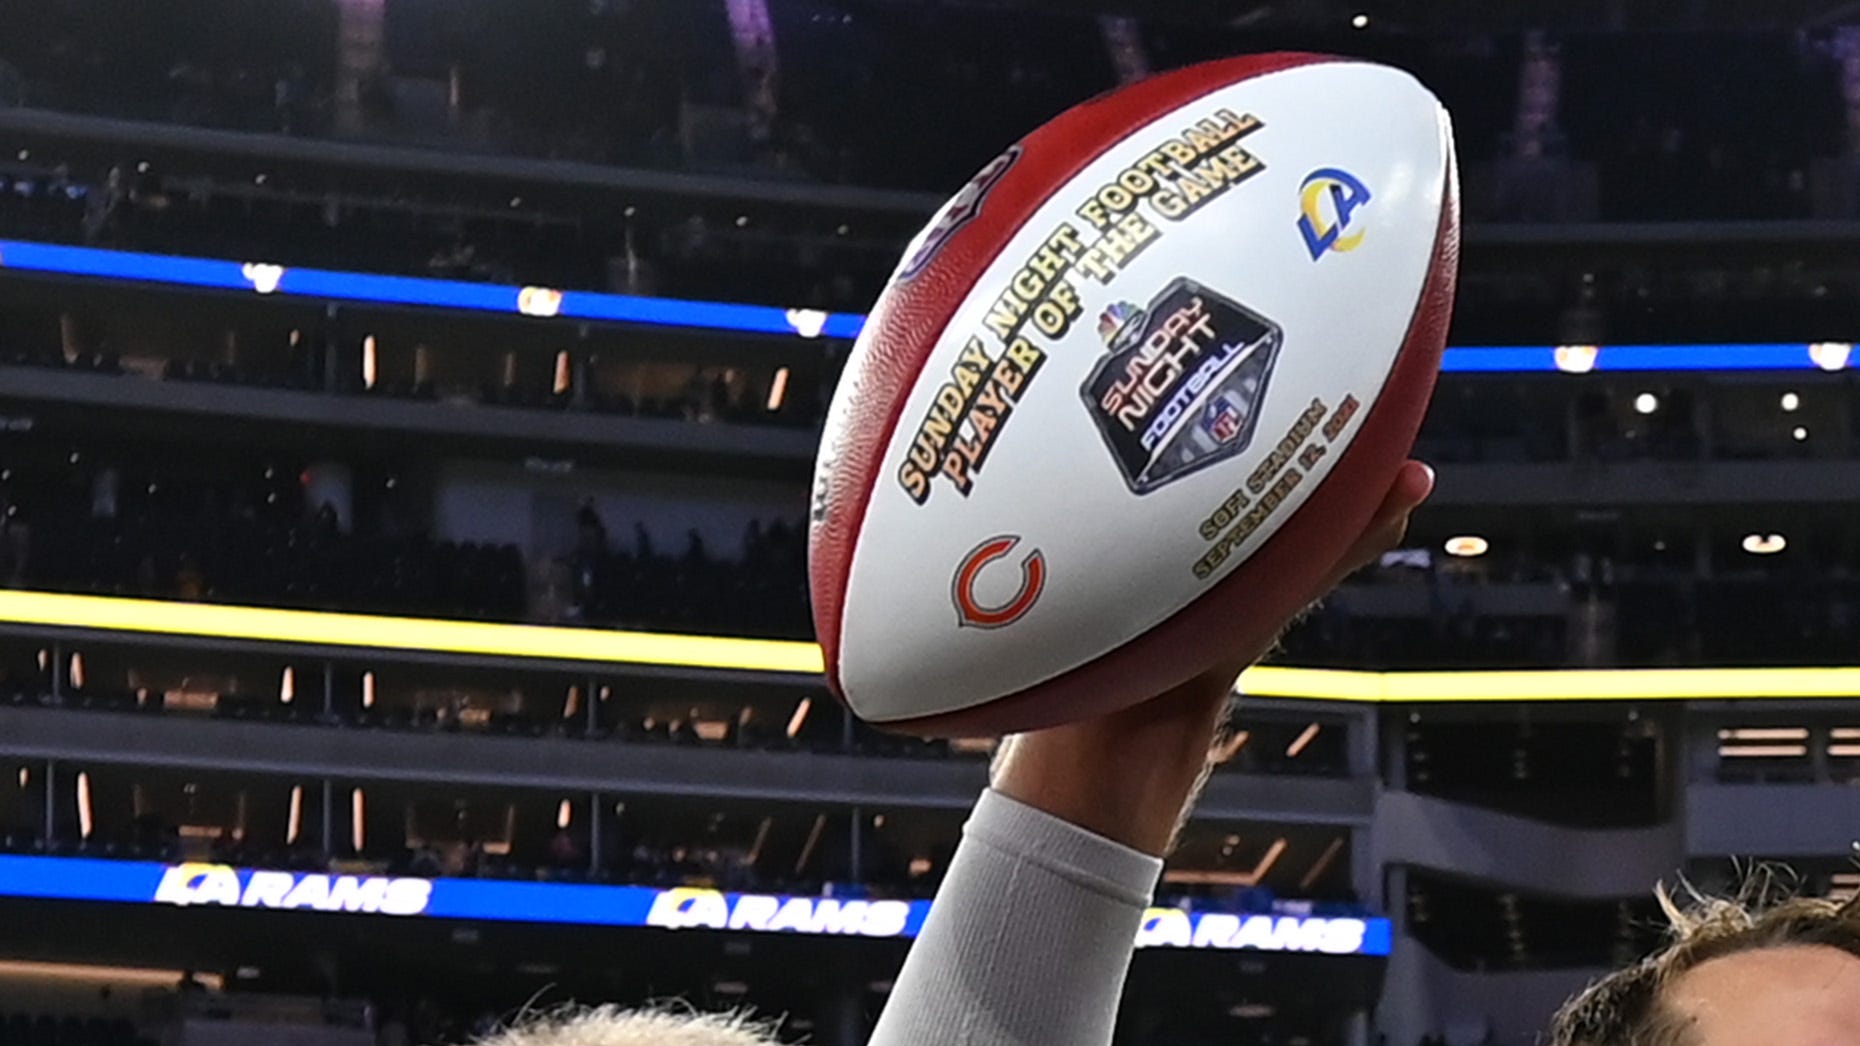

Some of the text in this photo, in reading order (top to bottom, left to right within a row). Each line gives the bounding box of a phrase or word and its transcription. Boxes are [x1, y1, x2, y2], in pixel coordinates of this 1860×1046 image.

[899, 334, 1000, 505] SUNDAY
[983, 222, 1080, 345] NIGHT
[1075, 108, 1265, 227] FOOTBALL
[942, 336, 1048, 498] PLAYER
[1032, 279, 1084, 341] OF
[1078, 212, 1162, 286] THE
[1149, 144, 1267, 222] GAME
[1101, 297, 1203, 416] SUNDAY
[1117, 313, 1216, 432] NIGHT
[1141, 342, 1246, 450] FOOTBALL
[1246, 397, 1328, 494] STADIUM
[1192, 468, 1303, 580] SEPTEMBER
[241, 870, 432, 915] RAMS
[728, 894, 909, 936] RAMS
[1190, 913, 1366, 953] RAMS
